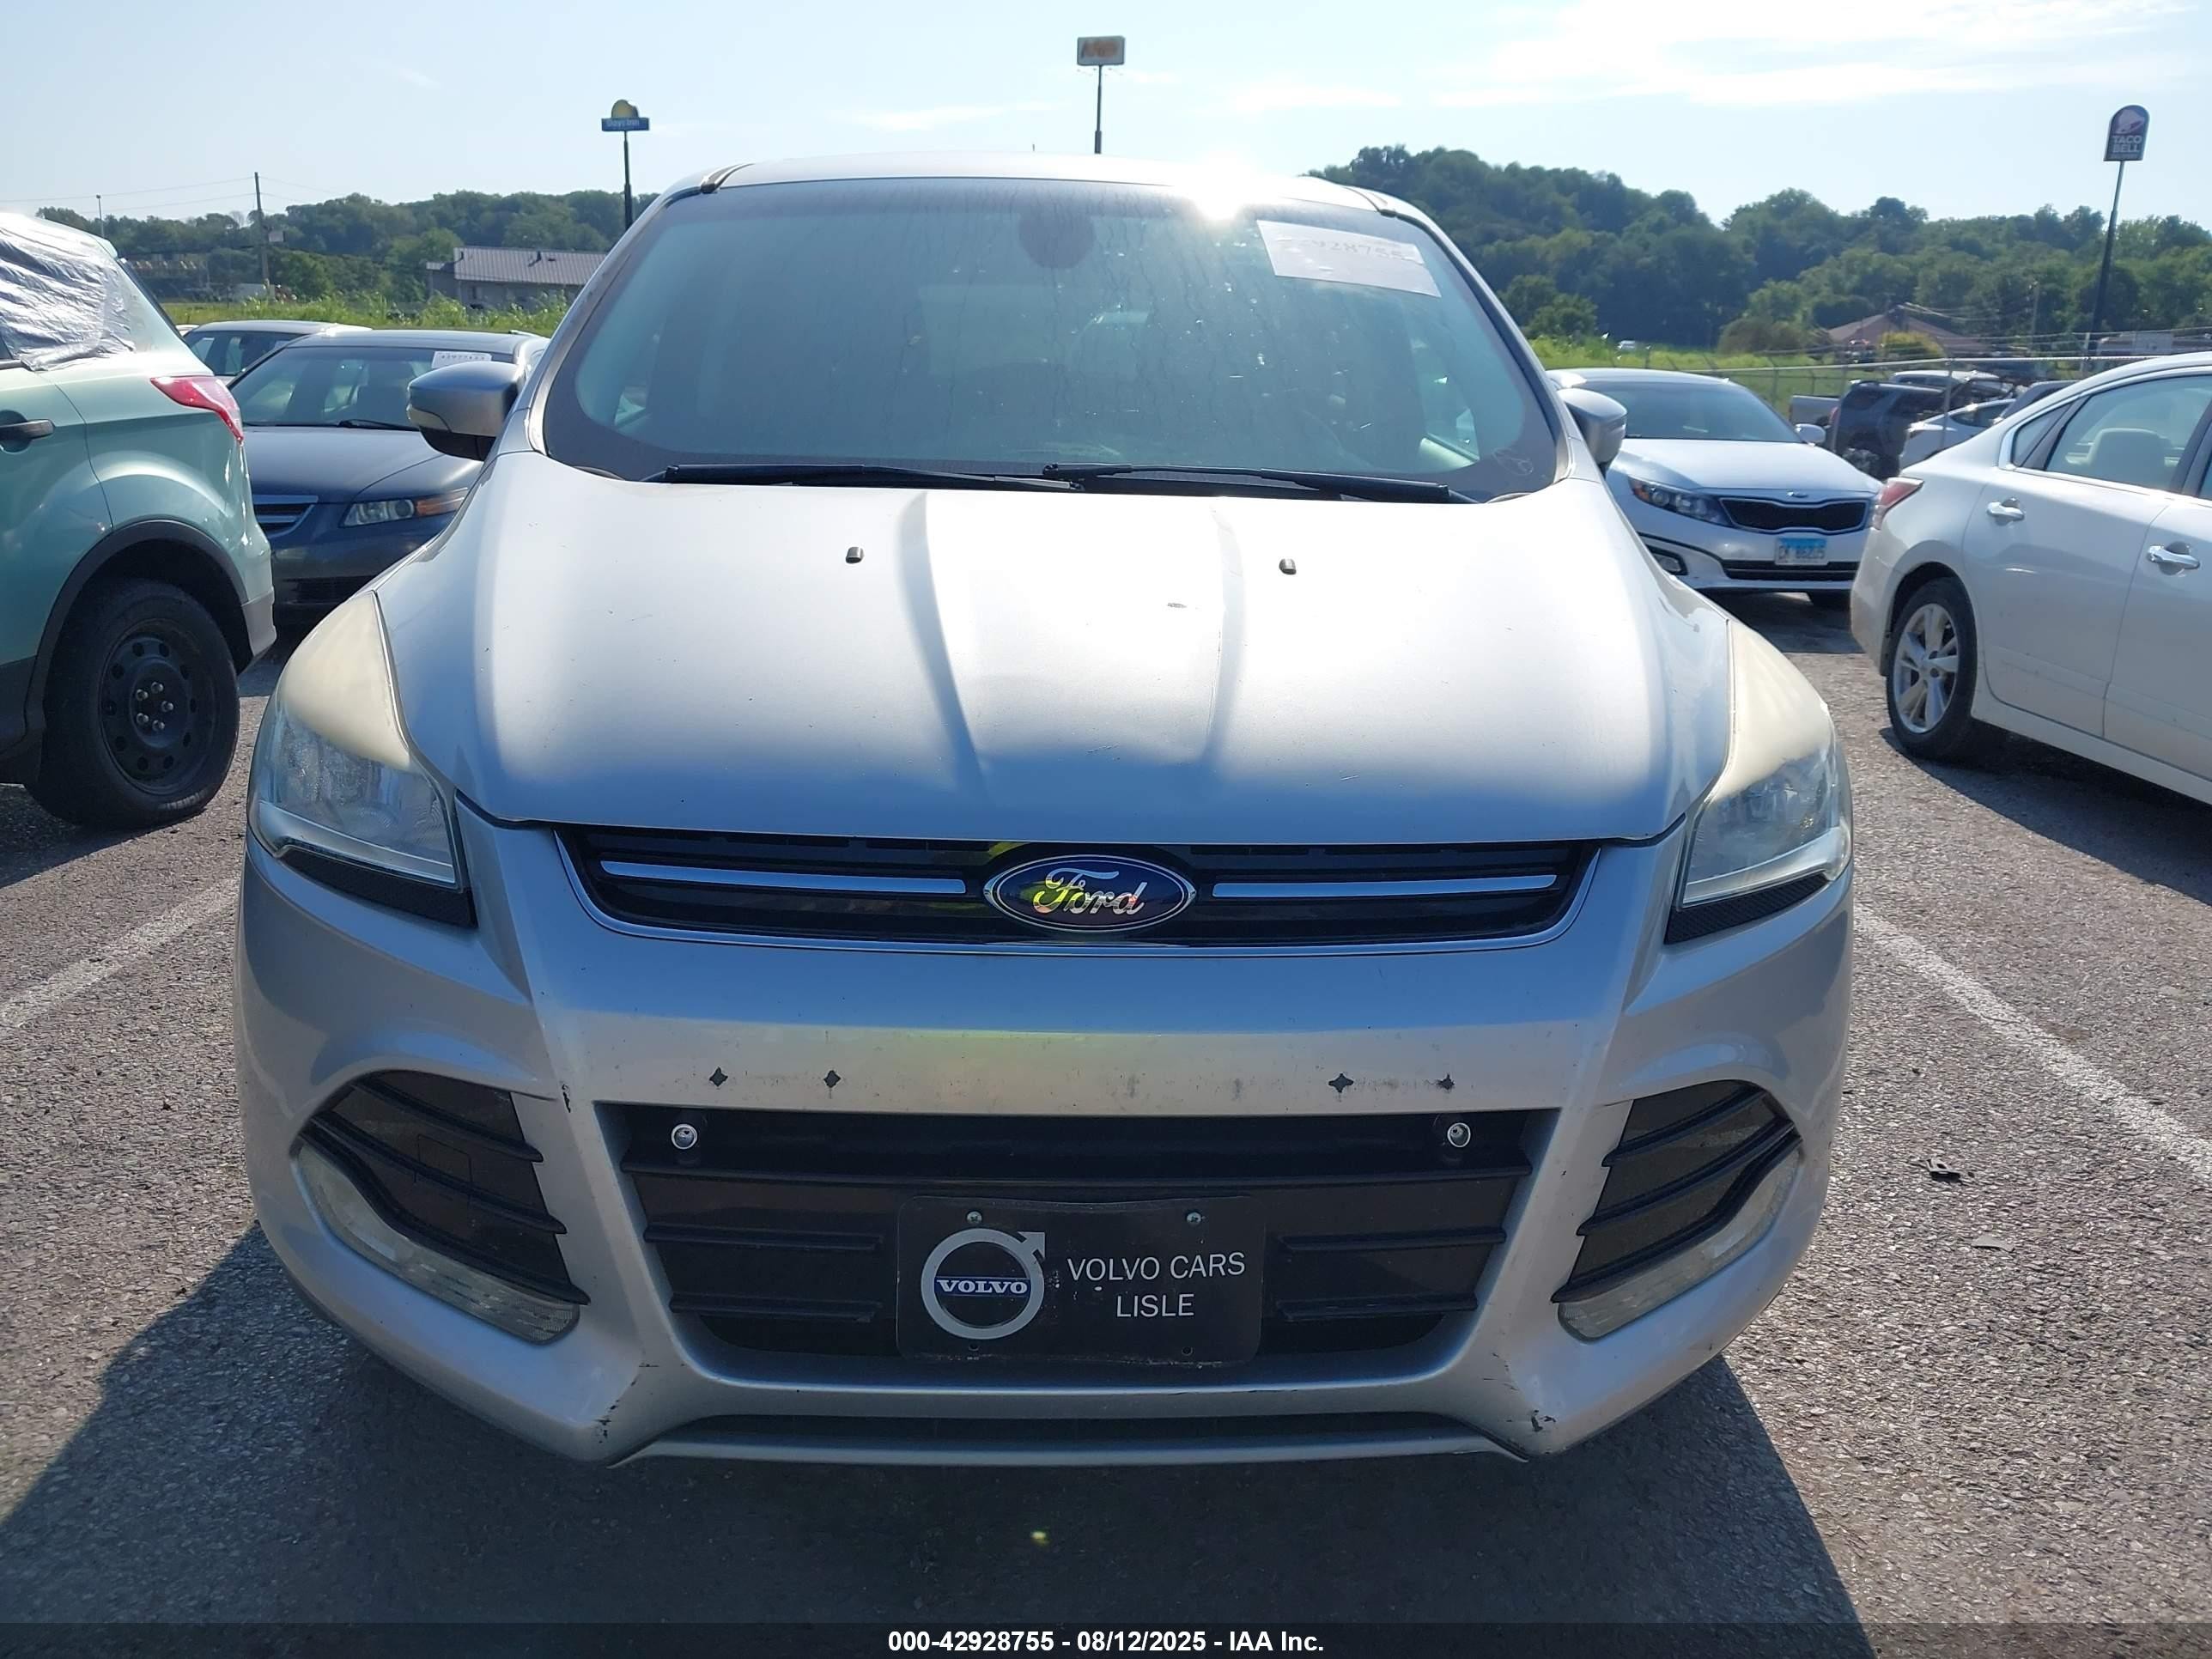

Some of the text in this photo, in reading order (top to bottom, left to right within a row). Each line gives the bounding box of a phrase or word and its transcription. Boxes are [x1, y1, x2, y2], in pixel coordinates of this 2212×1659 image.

[2113, 135, 2142, 144] TACO
[2113, 144, 2140, 153] BELL
[1033, 867, 1147, 914] Ford
[1066, 1252, 1245, 1281] VOLVO CARS
[937, 1279, 1029, 1295] VOLVO
[1116, 1293, 1194, 1318] LISLE
